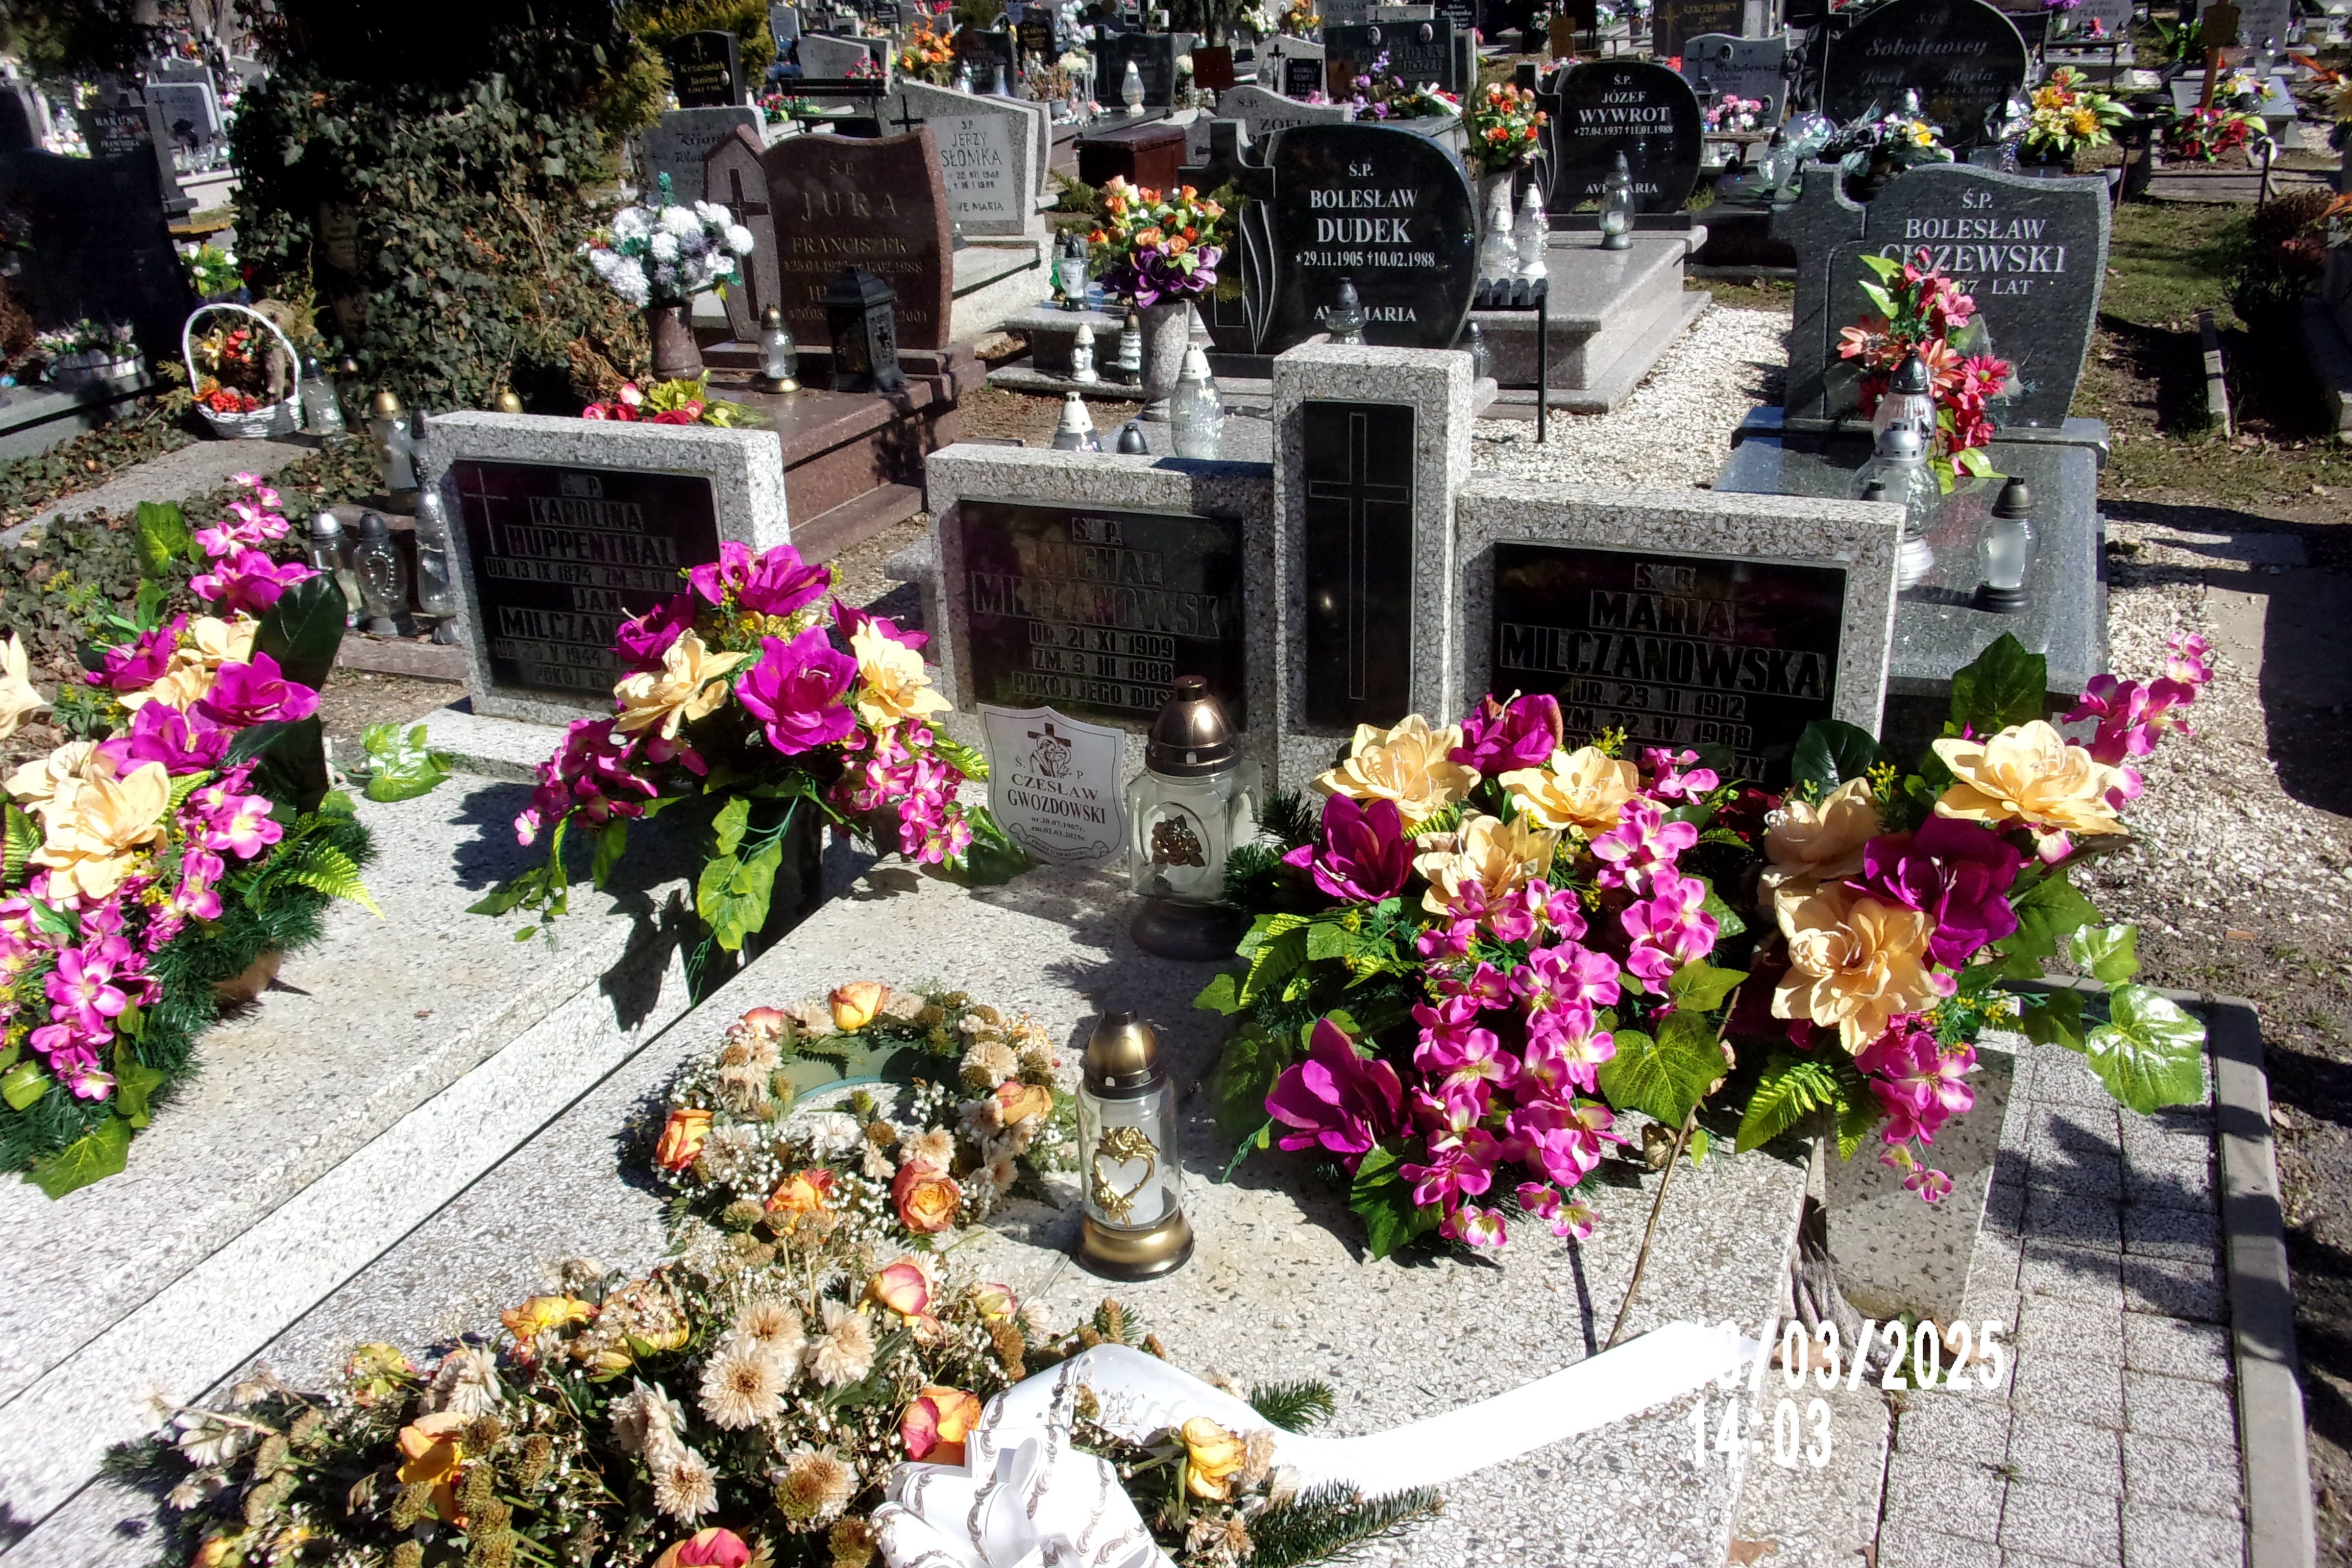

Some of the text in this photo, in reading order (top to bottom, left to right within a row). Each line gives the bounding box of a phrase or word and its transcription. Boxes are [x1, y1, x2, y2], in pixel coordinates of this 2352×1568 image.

[1601, 89, 1647, 104] JÓZEF
[1579, 107, 1670, 124] WYWROT
[951, 132, 987, 147] JERZY
[941, 149, 1002, 167] SŁOMKA
[801, 191, 900, 222] JURA
[973, 202, 1004, 212] MARIA
[1310, 189, 1418, 208] BOLESŁAW
[1317, 218, 1413, 243] DUDEK
[1905, 218, 2048, 239] BOLESŁAW
[1991, 279, 2035, 295] LAT
[507, 525, 678, 566] HUPPENTHAL
[575, 588, 621, 612] JAN
[1591, 590, 1735, 640] MARIA
[1068, 627, 1086, 649] 21
[1097, 631, 1116, 653] XI
[1129, 633, 1175, 659] 1909
[1072, 653, 1086, 675] 3
[1097, 656, 1116, 678] III
[1129, 659, 1174, 684] 1988
[1501, 622, 1826, 700] MILCZANOWSKA
[1077, 679, 1122, 704] JEGO
[1618, 683, 1650, 709] 23
[1695, 692, 1746, 720] 1912
[1608, 711, 1640, 736] 22
[1655, 716, 1680, 741] IV
[1695, 721, 1753, 750] 1988
[1012, 773, 1098, 801] CZESŁAW
[1008, 789, 1106, 824] GWOZDOWSKI
